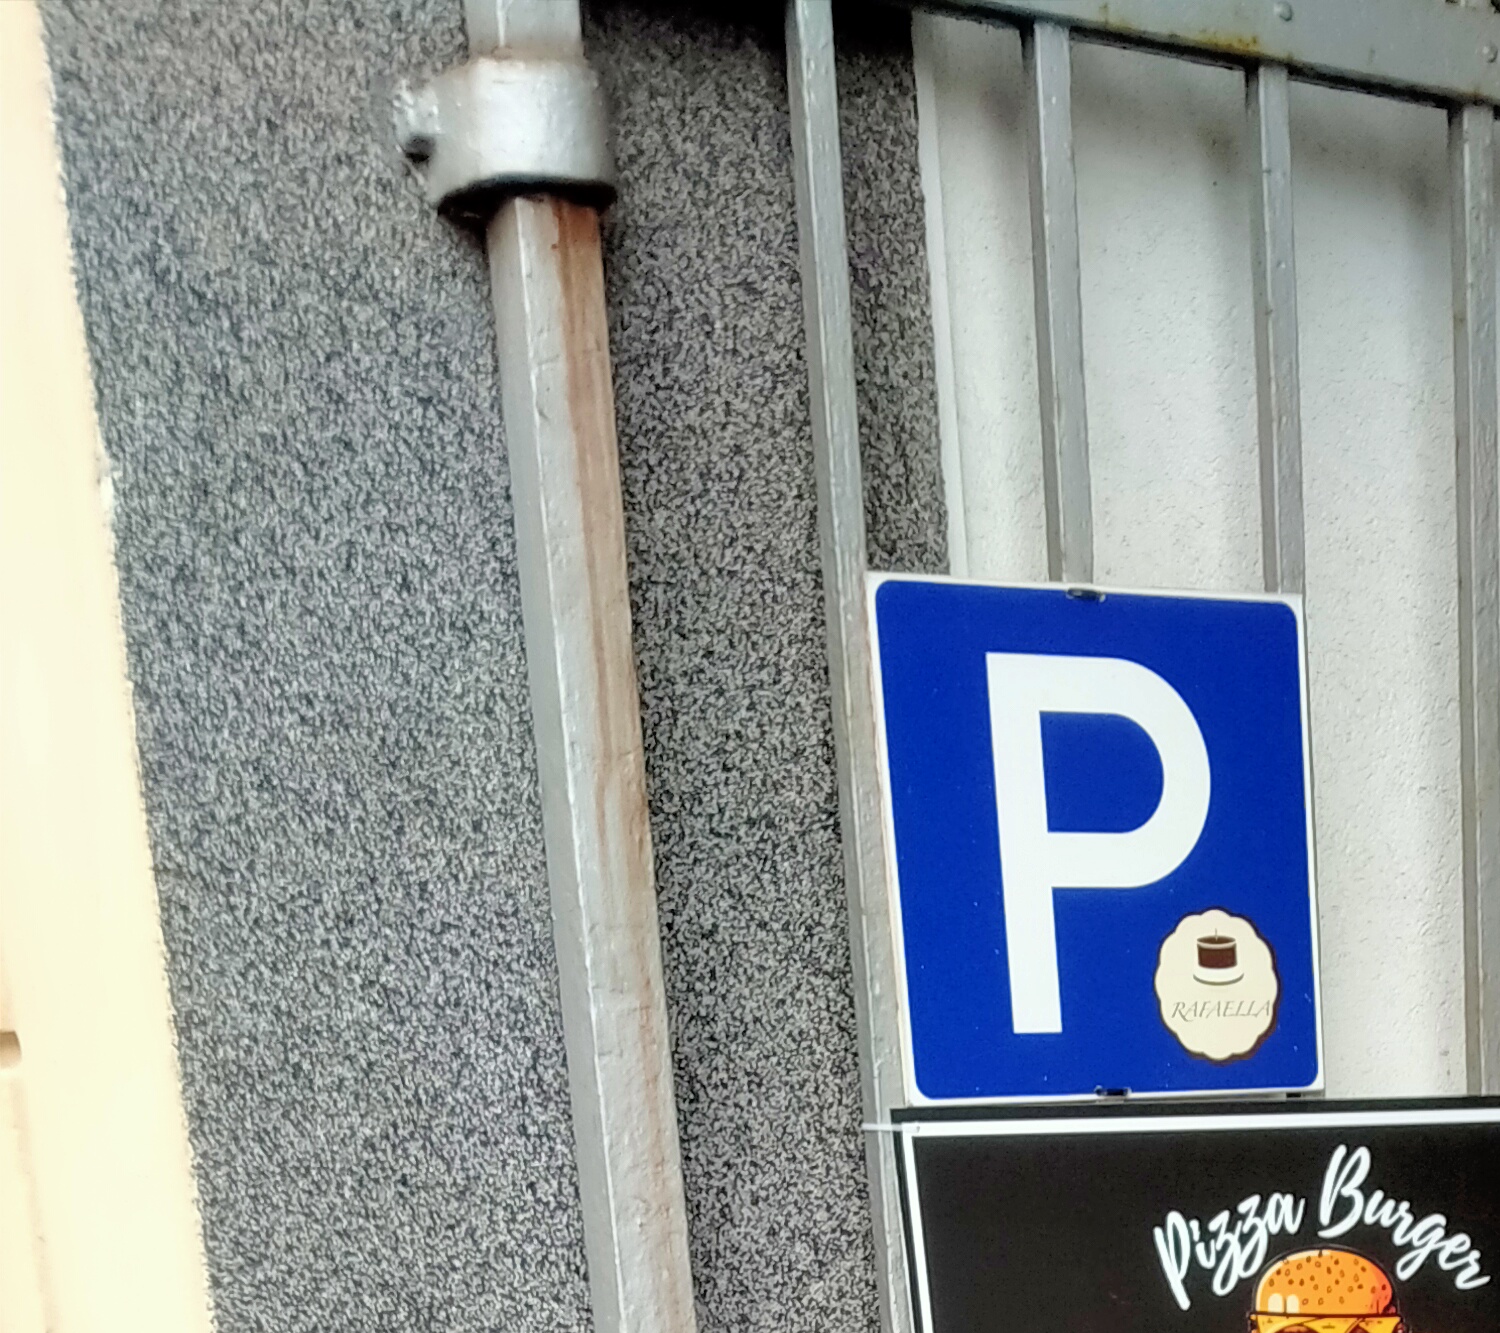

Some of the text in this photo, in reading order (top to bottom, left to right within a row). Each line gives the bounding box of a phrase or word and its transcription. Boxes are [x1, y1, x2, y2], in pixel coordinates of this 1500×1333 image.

[986, 651, 1211, 1034] P
[1171, 999, 1271, 1022] RAFAELLA
[1153, 1143, 1492, 1311] Pizza Burger
